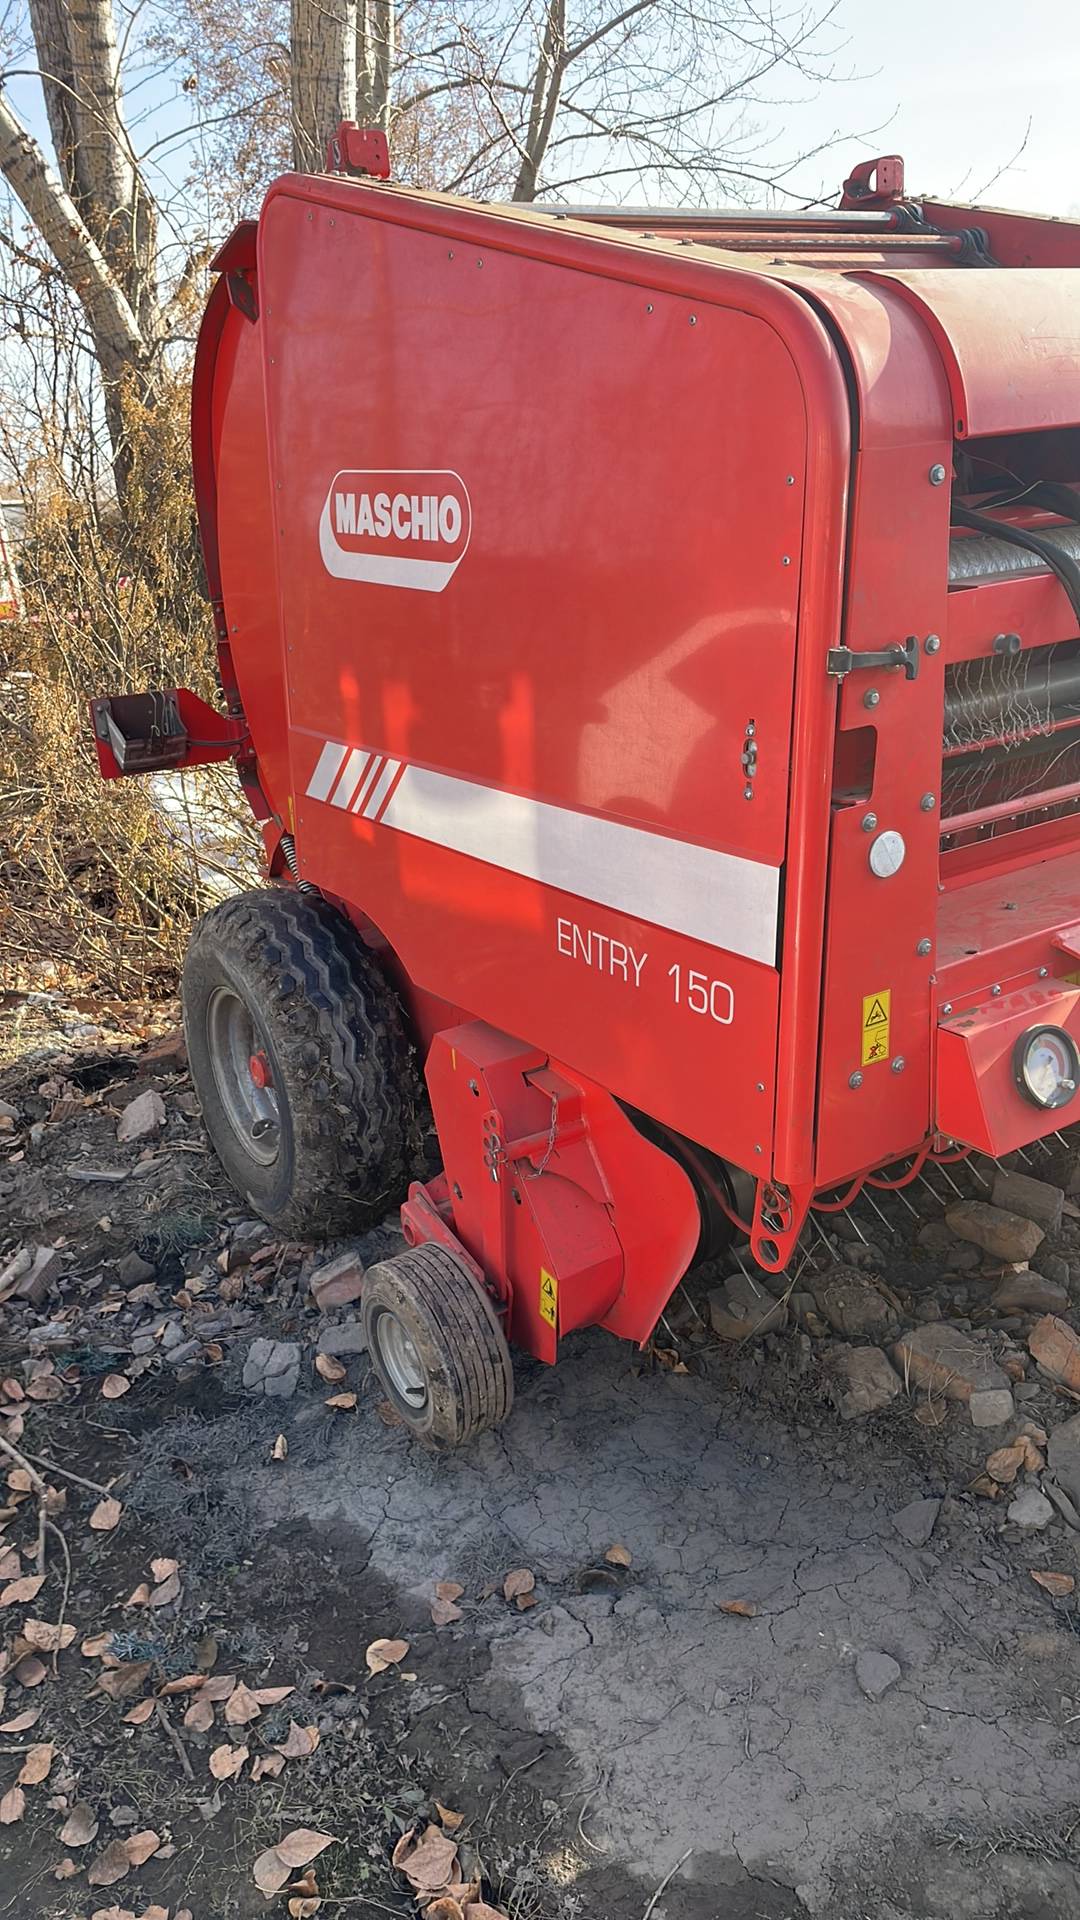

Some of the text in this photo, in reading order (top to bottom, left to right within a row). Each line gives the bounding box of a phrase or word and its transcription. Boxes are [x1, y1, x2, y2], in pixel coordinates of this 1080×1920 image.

[335, 492, 462, 544] MASCHIO
[557, 917, 735, 1025] ENTRY 150
